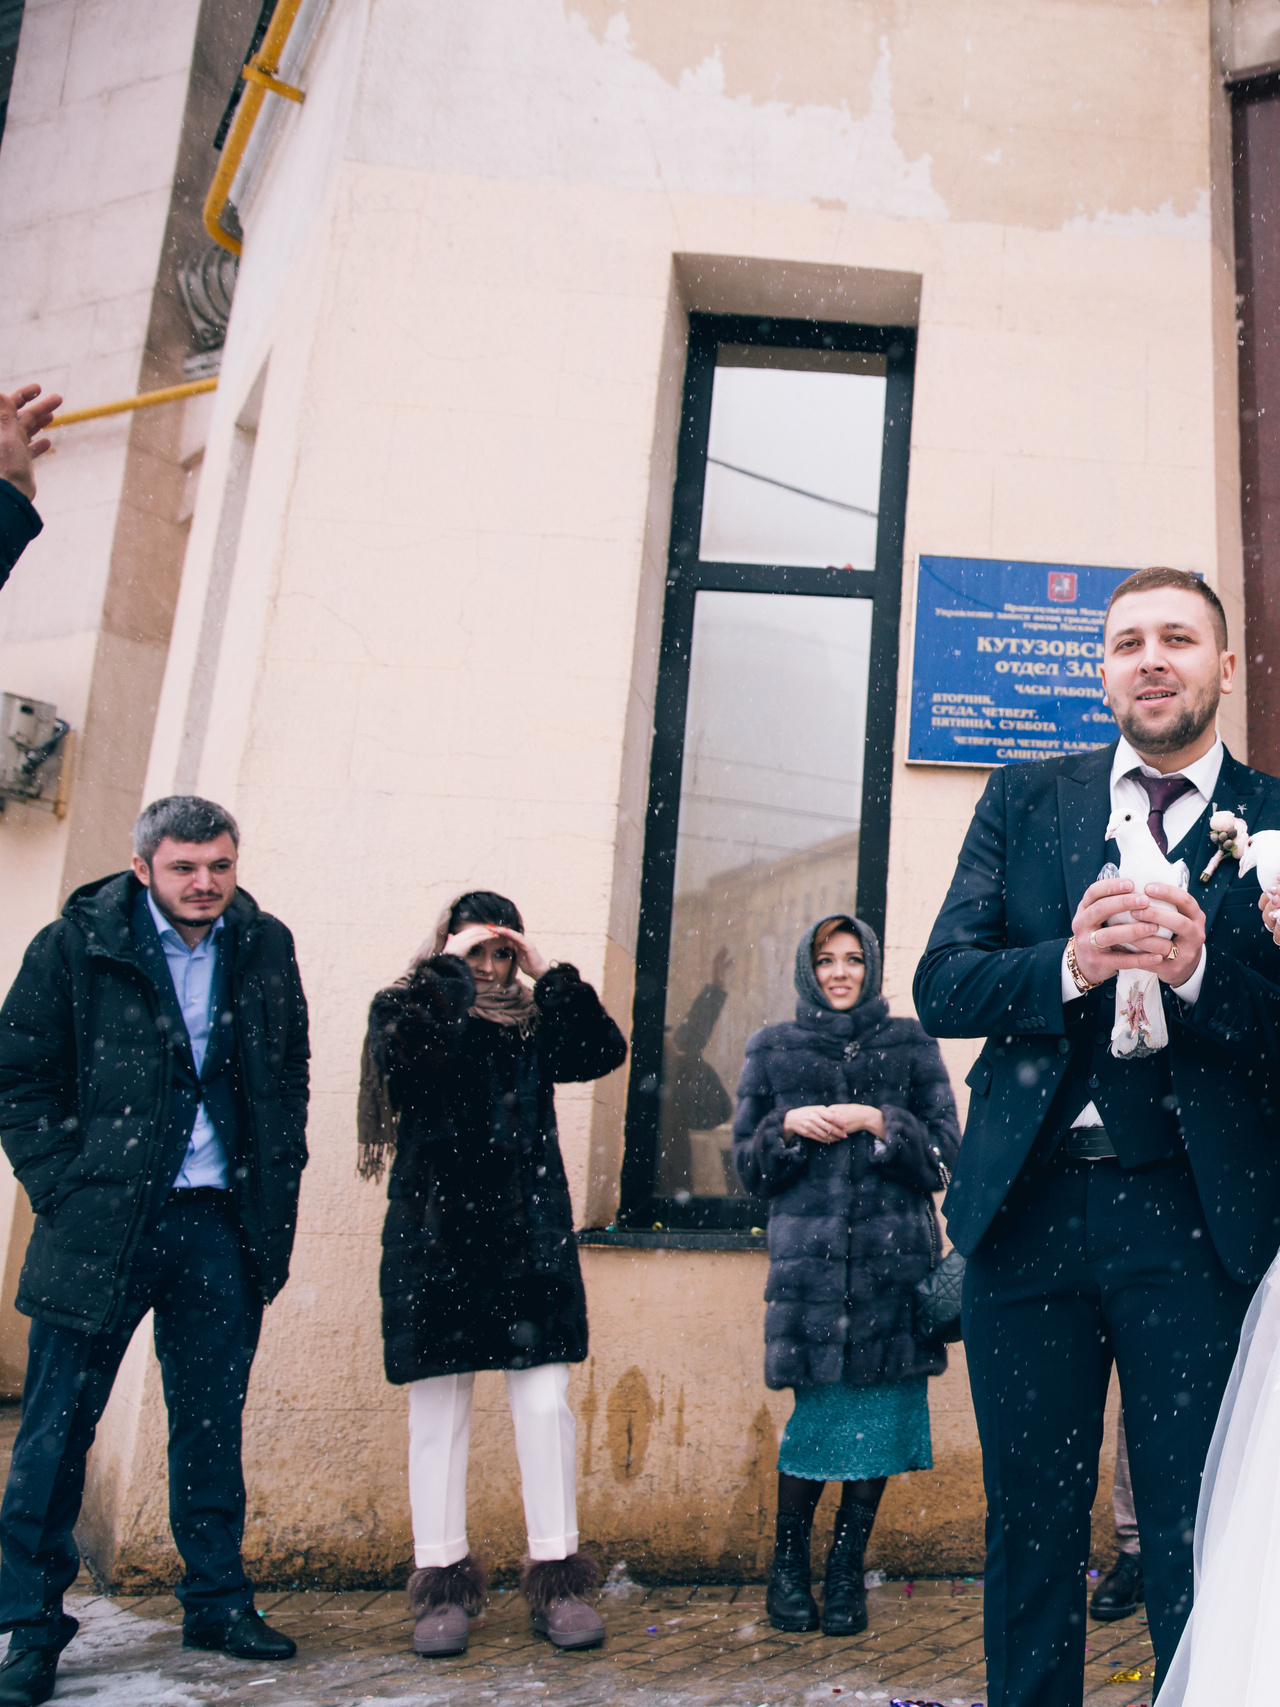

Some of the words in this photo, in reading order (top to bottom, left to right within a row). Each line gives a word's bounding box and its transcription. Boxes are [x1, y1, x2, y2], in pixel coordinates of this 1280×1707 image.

[977, 636, 1105, 658] КУТУЗОВСК
[995, 660, 1059, 677] отдел
[1065, 661, 1102, 678] ЗАГ
[1014, 684, 1051, 695] ЧАСЫ
[1054, 686, 1104, 698] РАБОТЫ
[999, 719, 1057, 732] СУББОТА
[953, 736, 1015, 747] ЧЕТВЕРТЫЙ
[1017, 739, 1061, 749] ЧЕТВЕРГ
